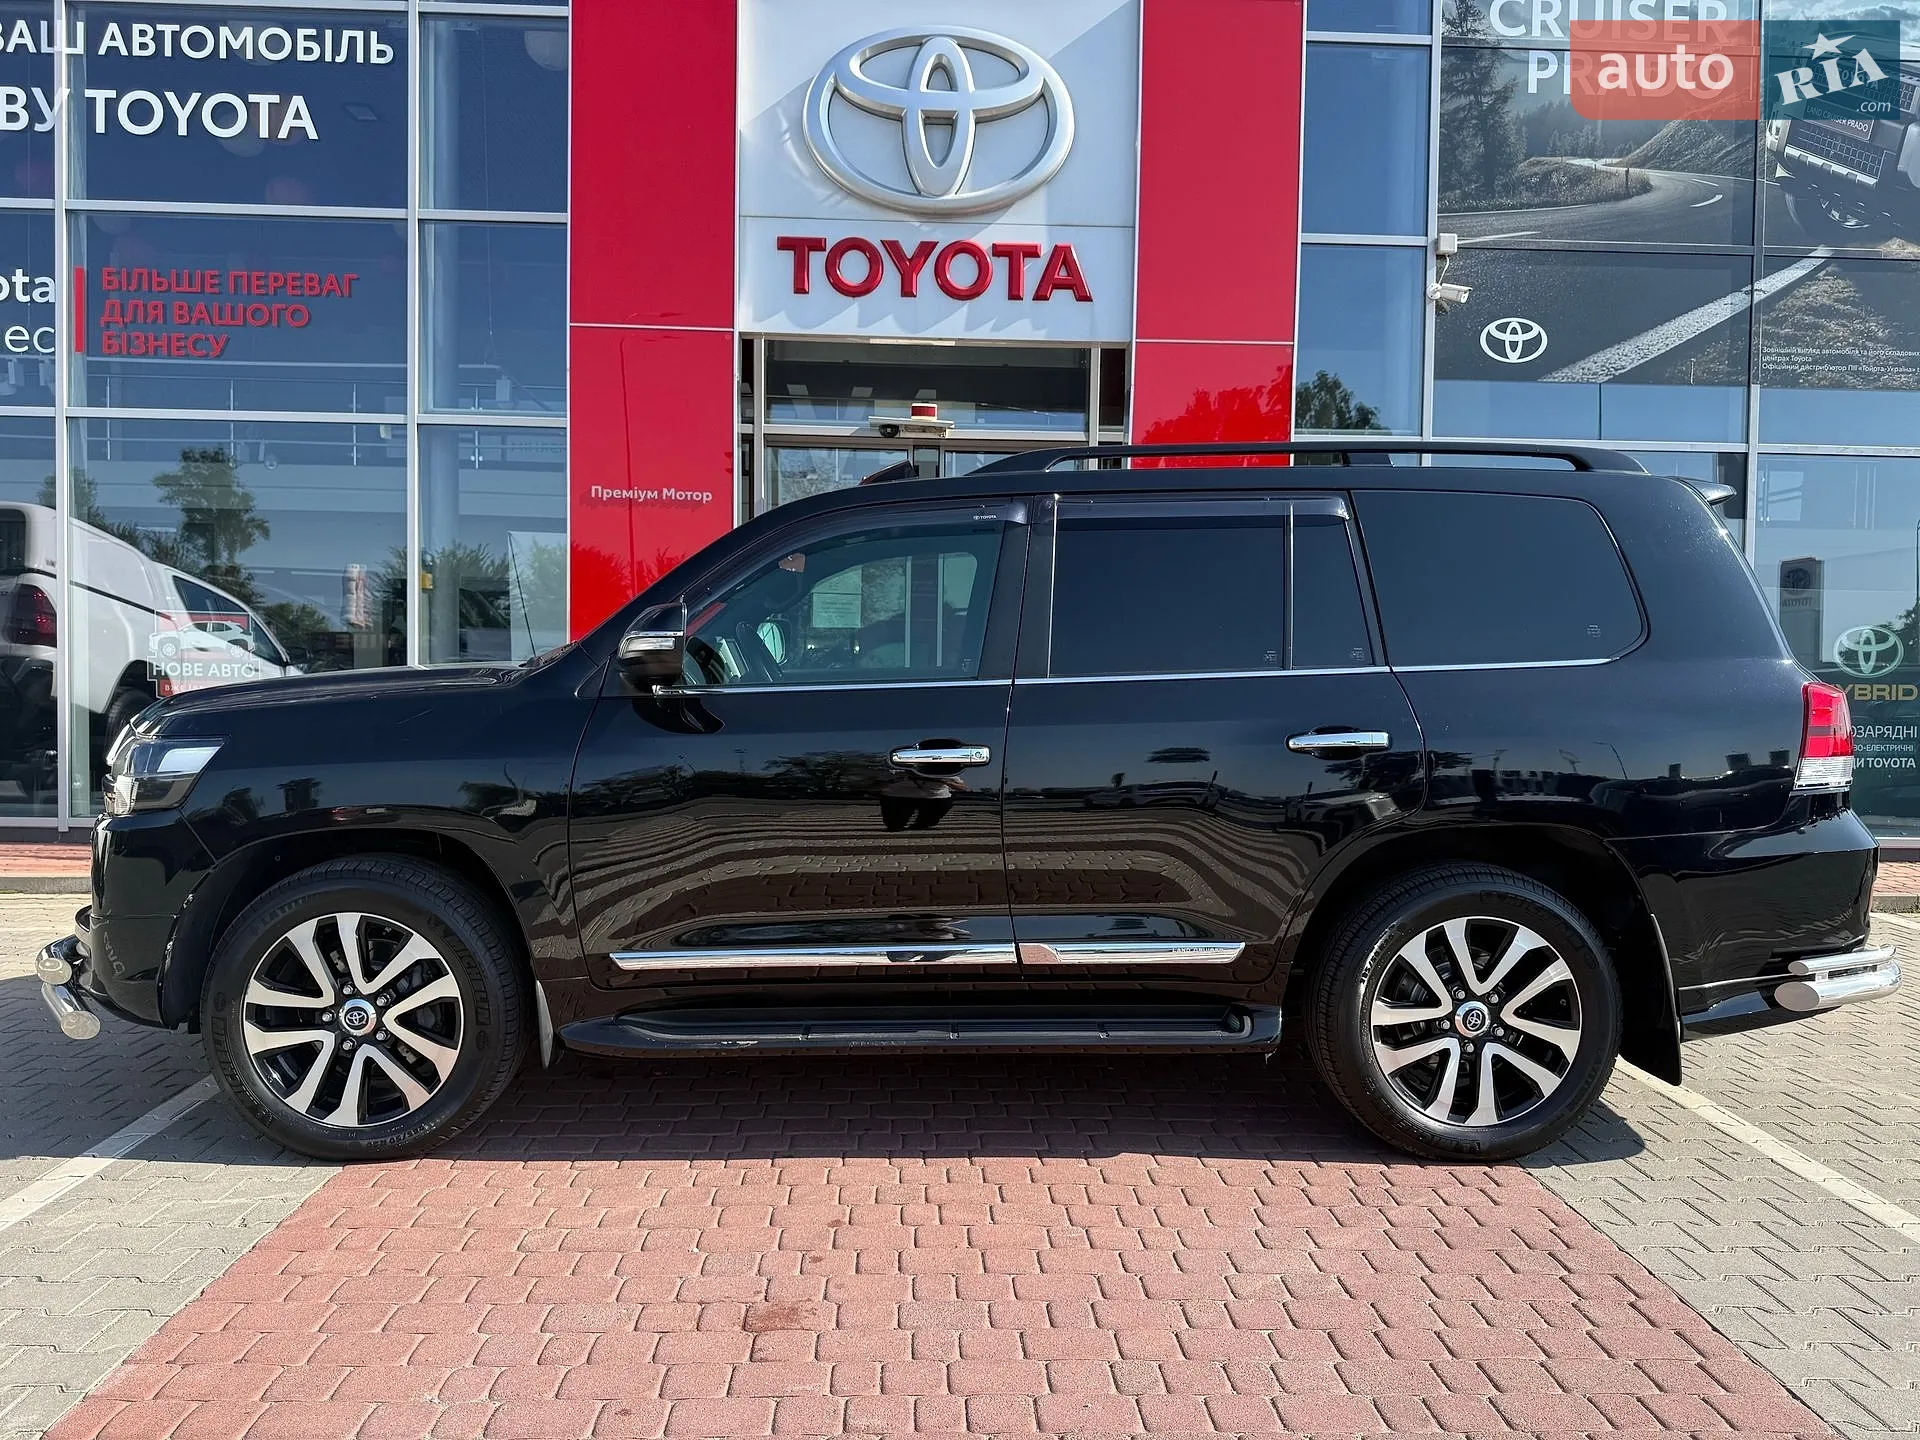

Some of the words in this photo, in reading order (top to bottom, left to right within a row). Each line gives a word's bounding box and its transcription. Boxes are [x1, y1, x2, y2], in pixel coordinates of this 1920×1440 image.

[0, 20, 85, 55] АШ
[98, 22, 395, 65] АВТОМОБІЛЬ
[84, 88, 319, 140] TOYOTA
[1847, 119, 1869, 132] PRADO
[101, 268, 220, 293] БІЛЬШЕ
[228, 271, 358, 297] ПЕРЕВАГ
[776, 236, 1093, 302] TOYOTA
[100, 299, 164, 327] ДЛЯ
[173, 301, 311, 328] ВАШОГО
[101, 331, 230, 358] БІЗНЕСУ
[591, 485, 658, 502] Преміум
[662, 487, 712, 503] Мотор
[153, 662, 203, 677] НОВЕ
[207, 663, 256, 677] АВТО
[1866, 757, 1916, 769] TOYOTA
